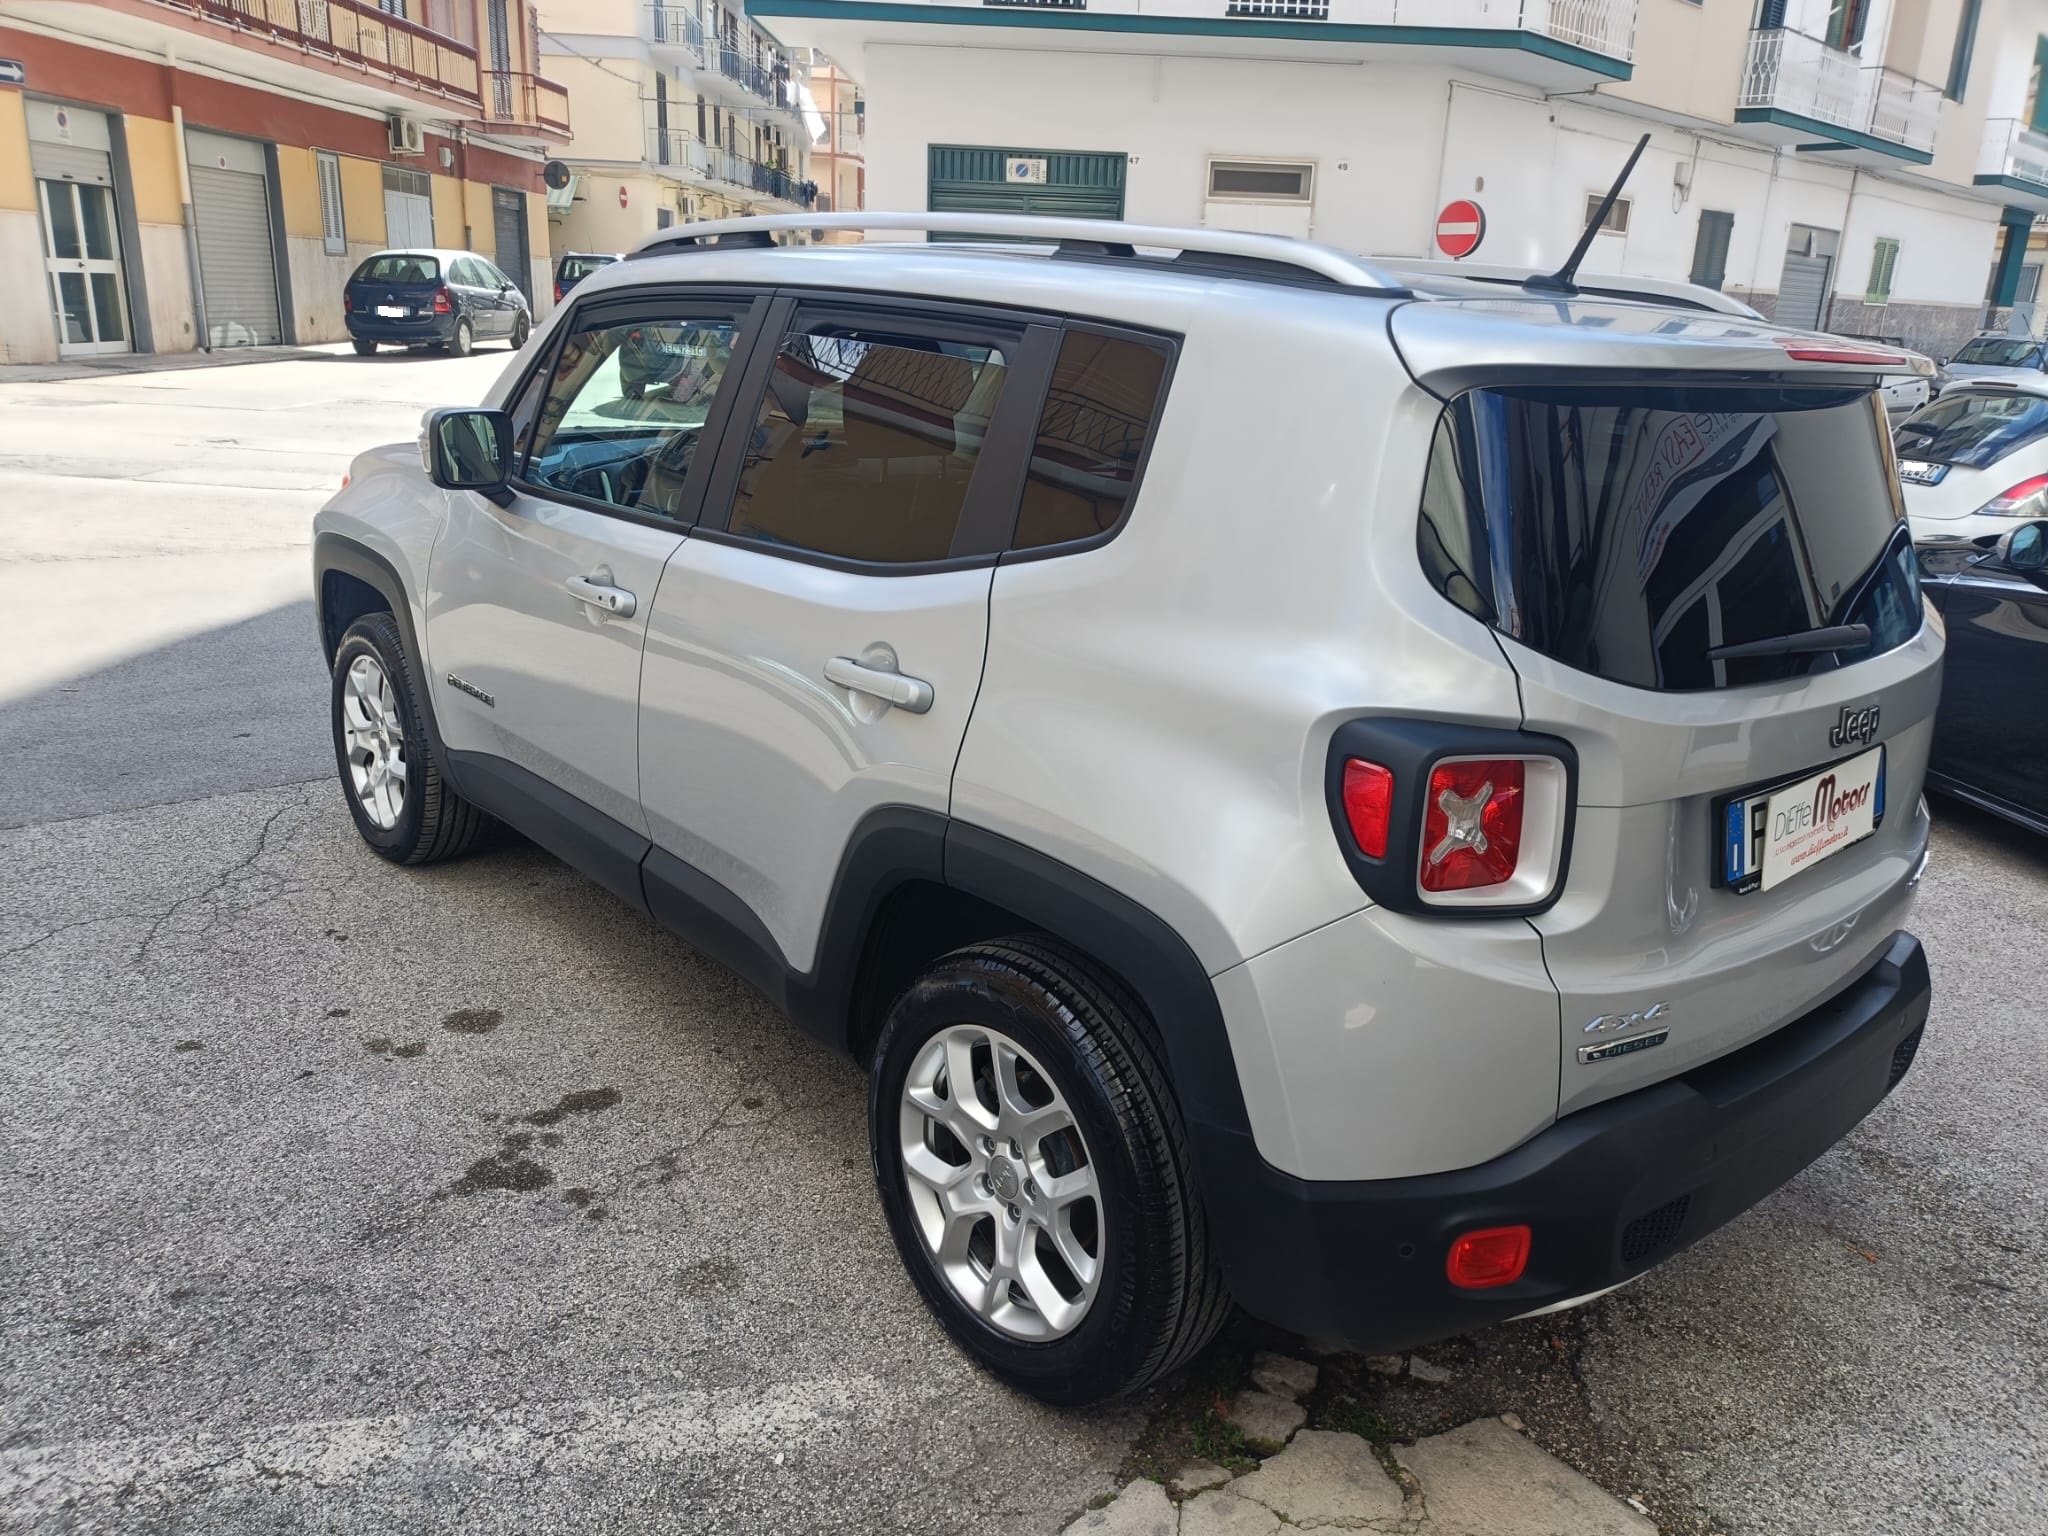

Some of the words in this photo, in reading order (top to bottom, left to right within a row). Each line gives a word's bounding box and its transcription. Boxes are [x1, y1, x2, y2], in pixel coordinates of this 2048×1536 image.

[1128, 156, 1140, 166] 47
[1829, 704, 1881, 748] Jeep
[1812, 773, 1871, 832] Motors
[1606, 1036, 1662, 1055] DIESEL
